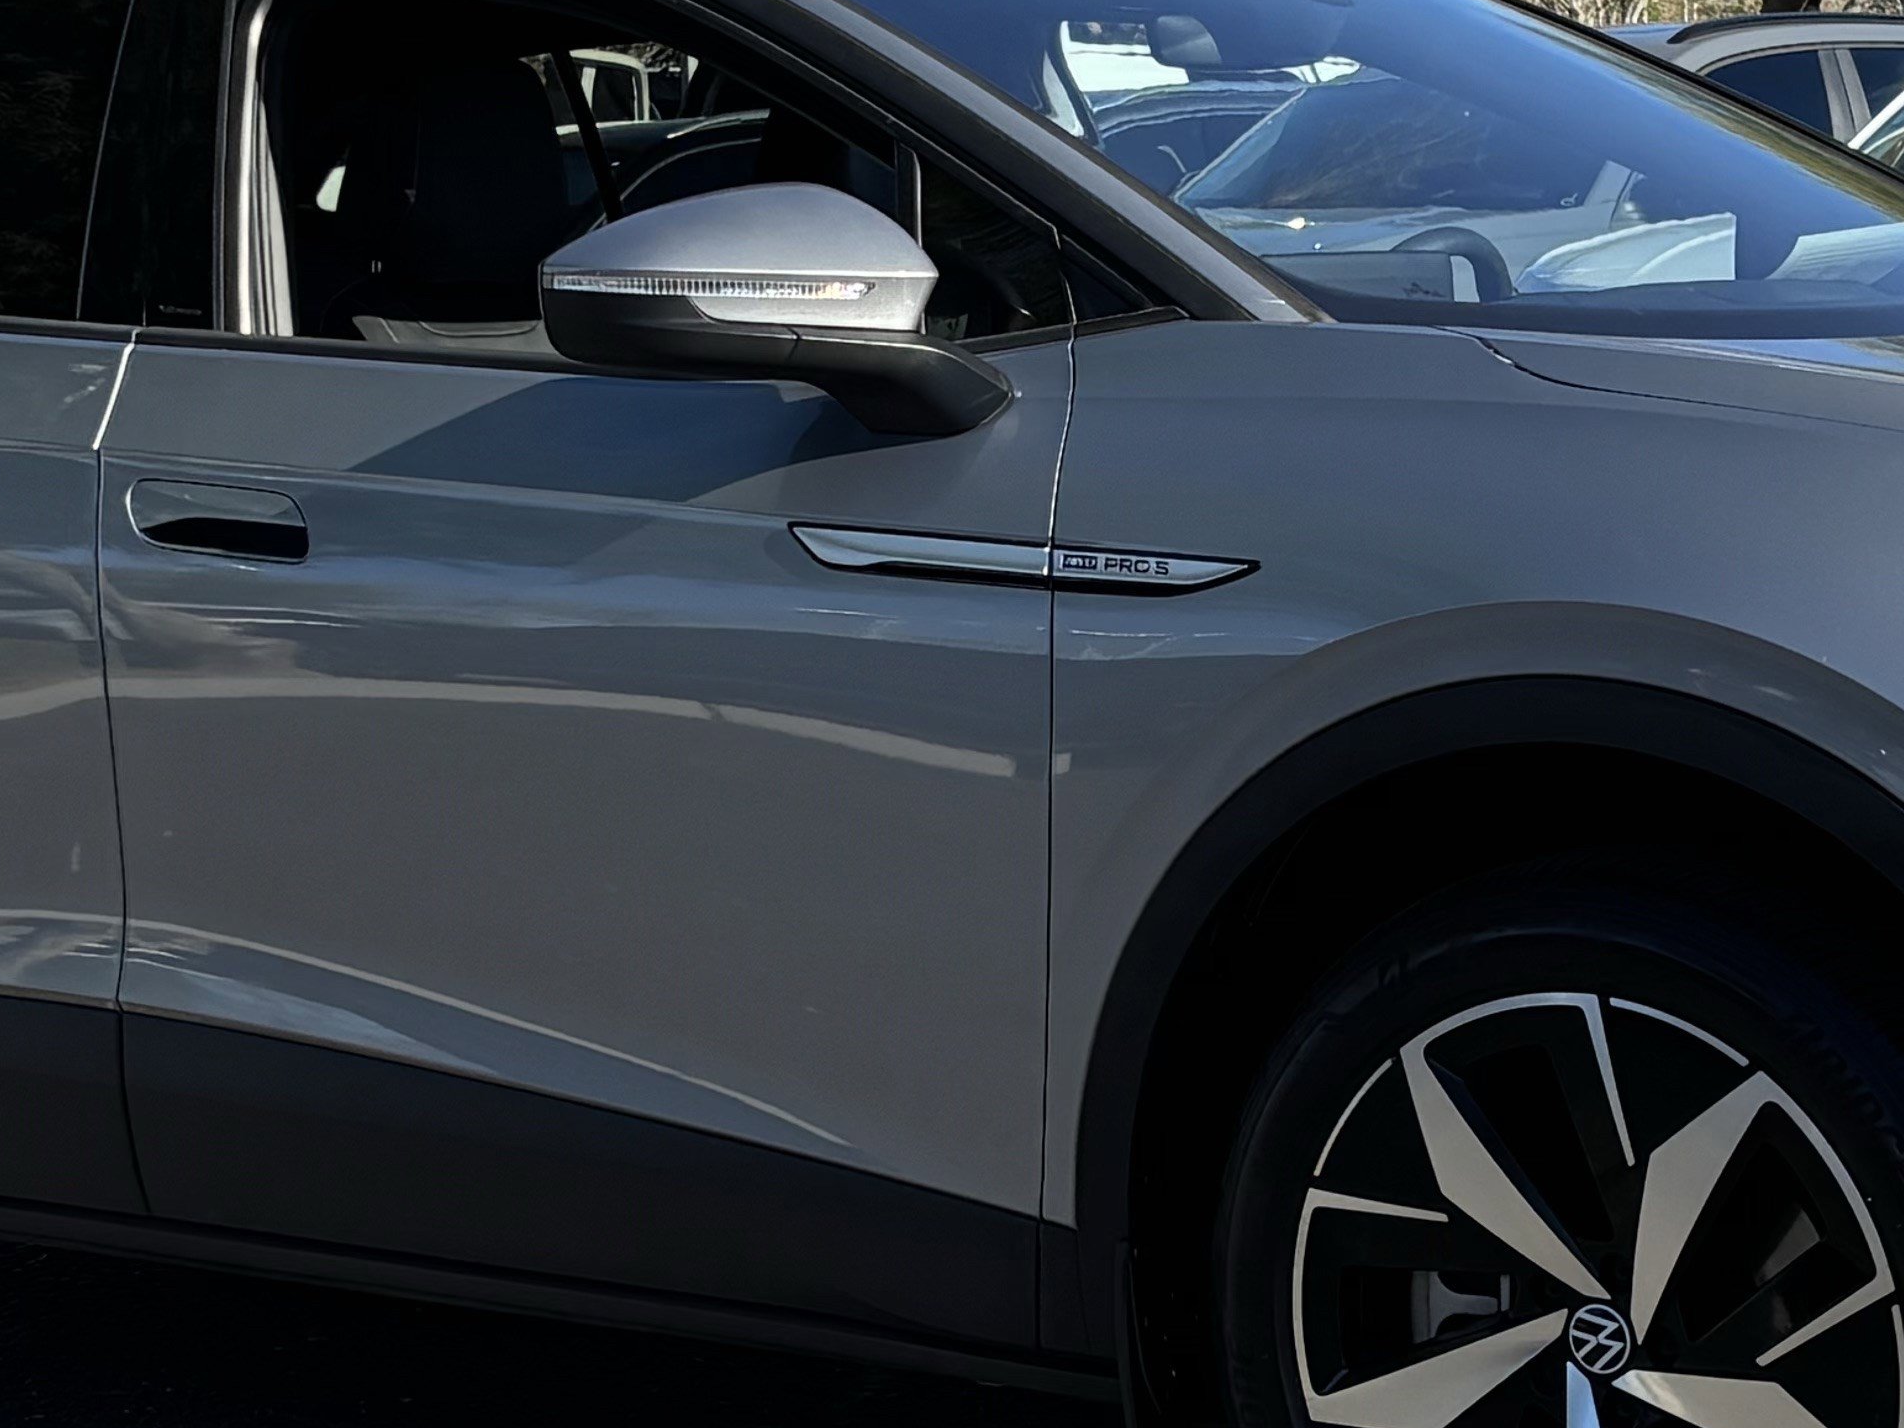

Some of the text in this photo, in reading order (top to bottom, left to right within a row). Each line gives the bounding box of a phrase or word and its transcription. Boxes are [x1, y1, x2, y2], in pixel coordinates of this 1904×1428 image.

[1104, 557, 1151, 573] PRO
[1154, 560, 1170, 575] S
[1569, 1304, 1631, 1374] VW
